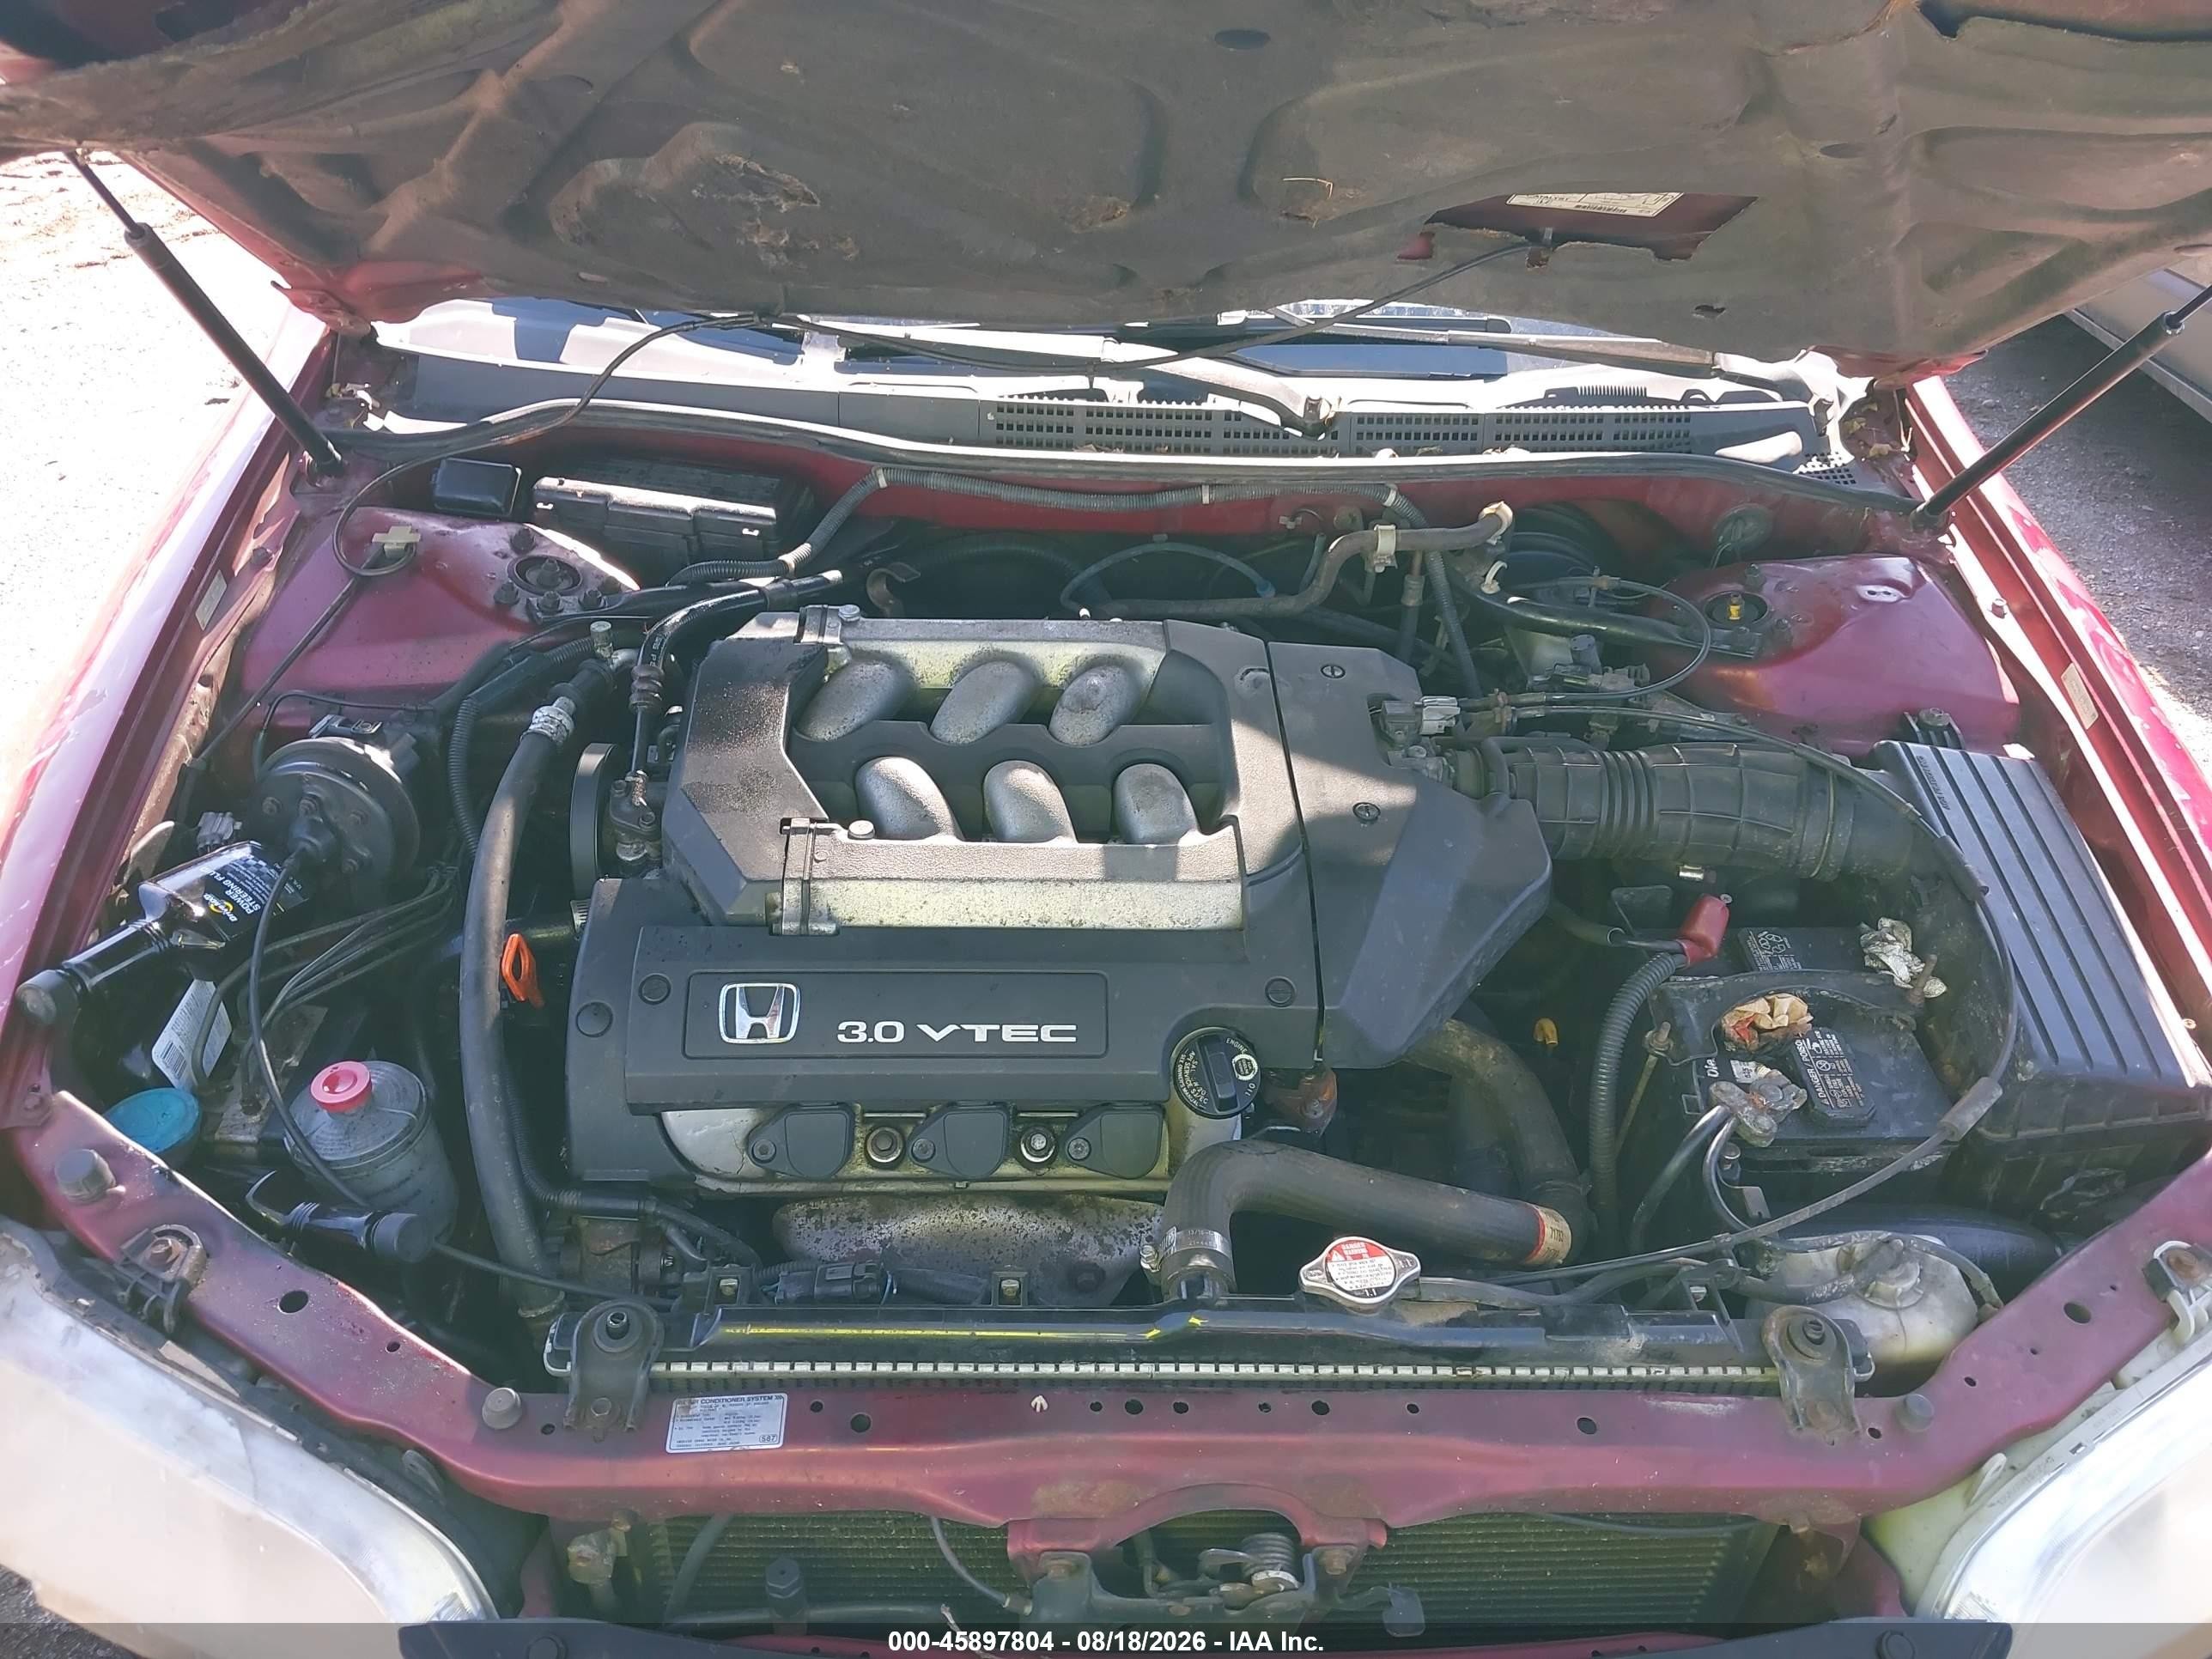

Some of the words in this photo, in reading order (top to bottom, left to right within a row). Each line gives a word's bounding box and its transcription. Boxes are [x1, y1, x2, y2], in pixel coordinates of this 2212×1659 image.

[222, 879, 261, 911] STEERING
[225, 890, 254, 915] POWER
[837, 1021, 904, 1044] 3.0
[915, 1024, 1078, 1044] VTEC
[1225, 1037, 1248, 1053] ENGINE
[1244, 1082, 1255, 1097] OIL
[1807, 1068, 1826, 1098] DANGER
